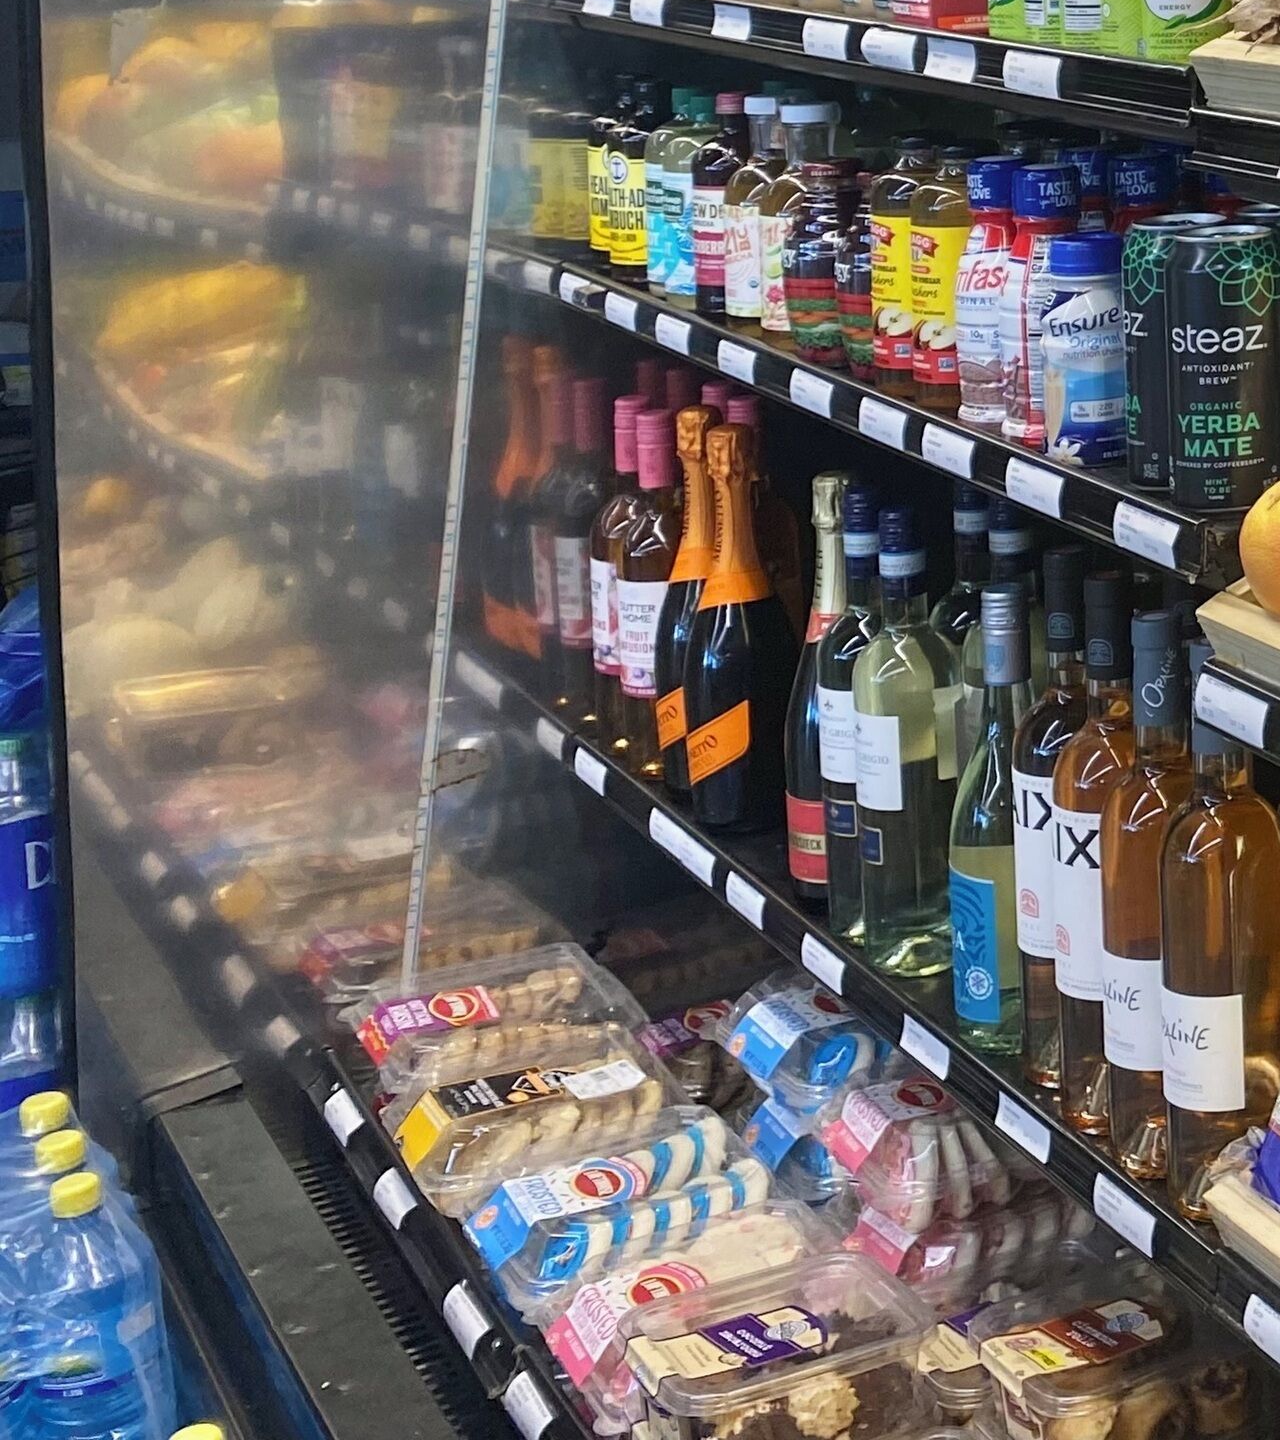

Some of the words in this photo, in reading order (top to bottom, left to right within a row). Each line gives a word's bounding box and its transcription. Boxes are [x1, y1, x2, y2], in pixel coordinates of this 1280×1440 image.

[1050, 307, 1122, 339] Ensure
[1189, 401, 1242, 411] ORGANIC
[1178, 412, 1261, 435] YERBA
[1184, 436, 1253, 458] MATE
[622, 613, 653, 625] HOME
